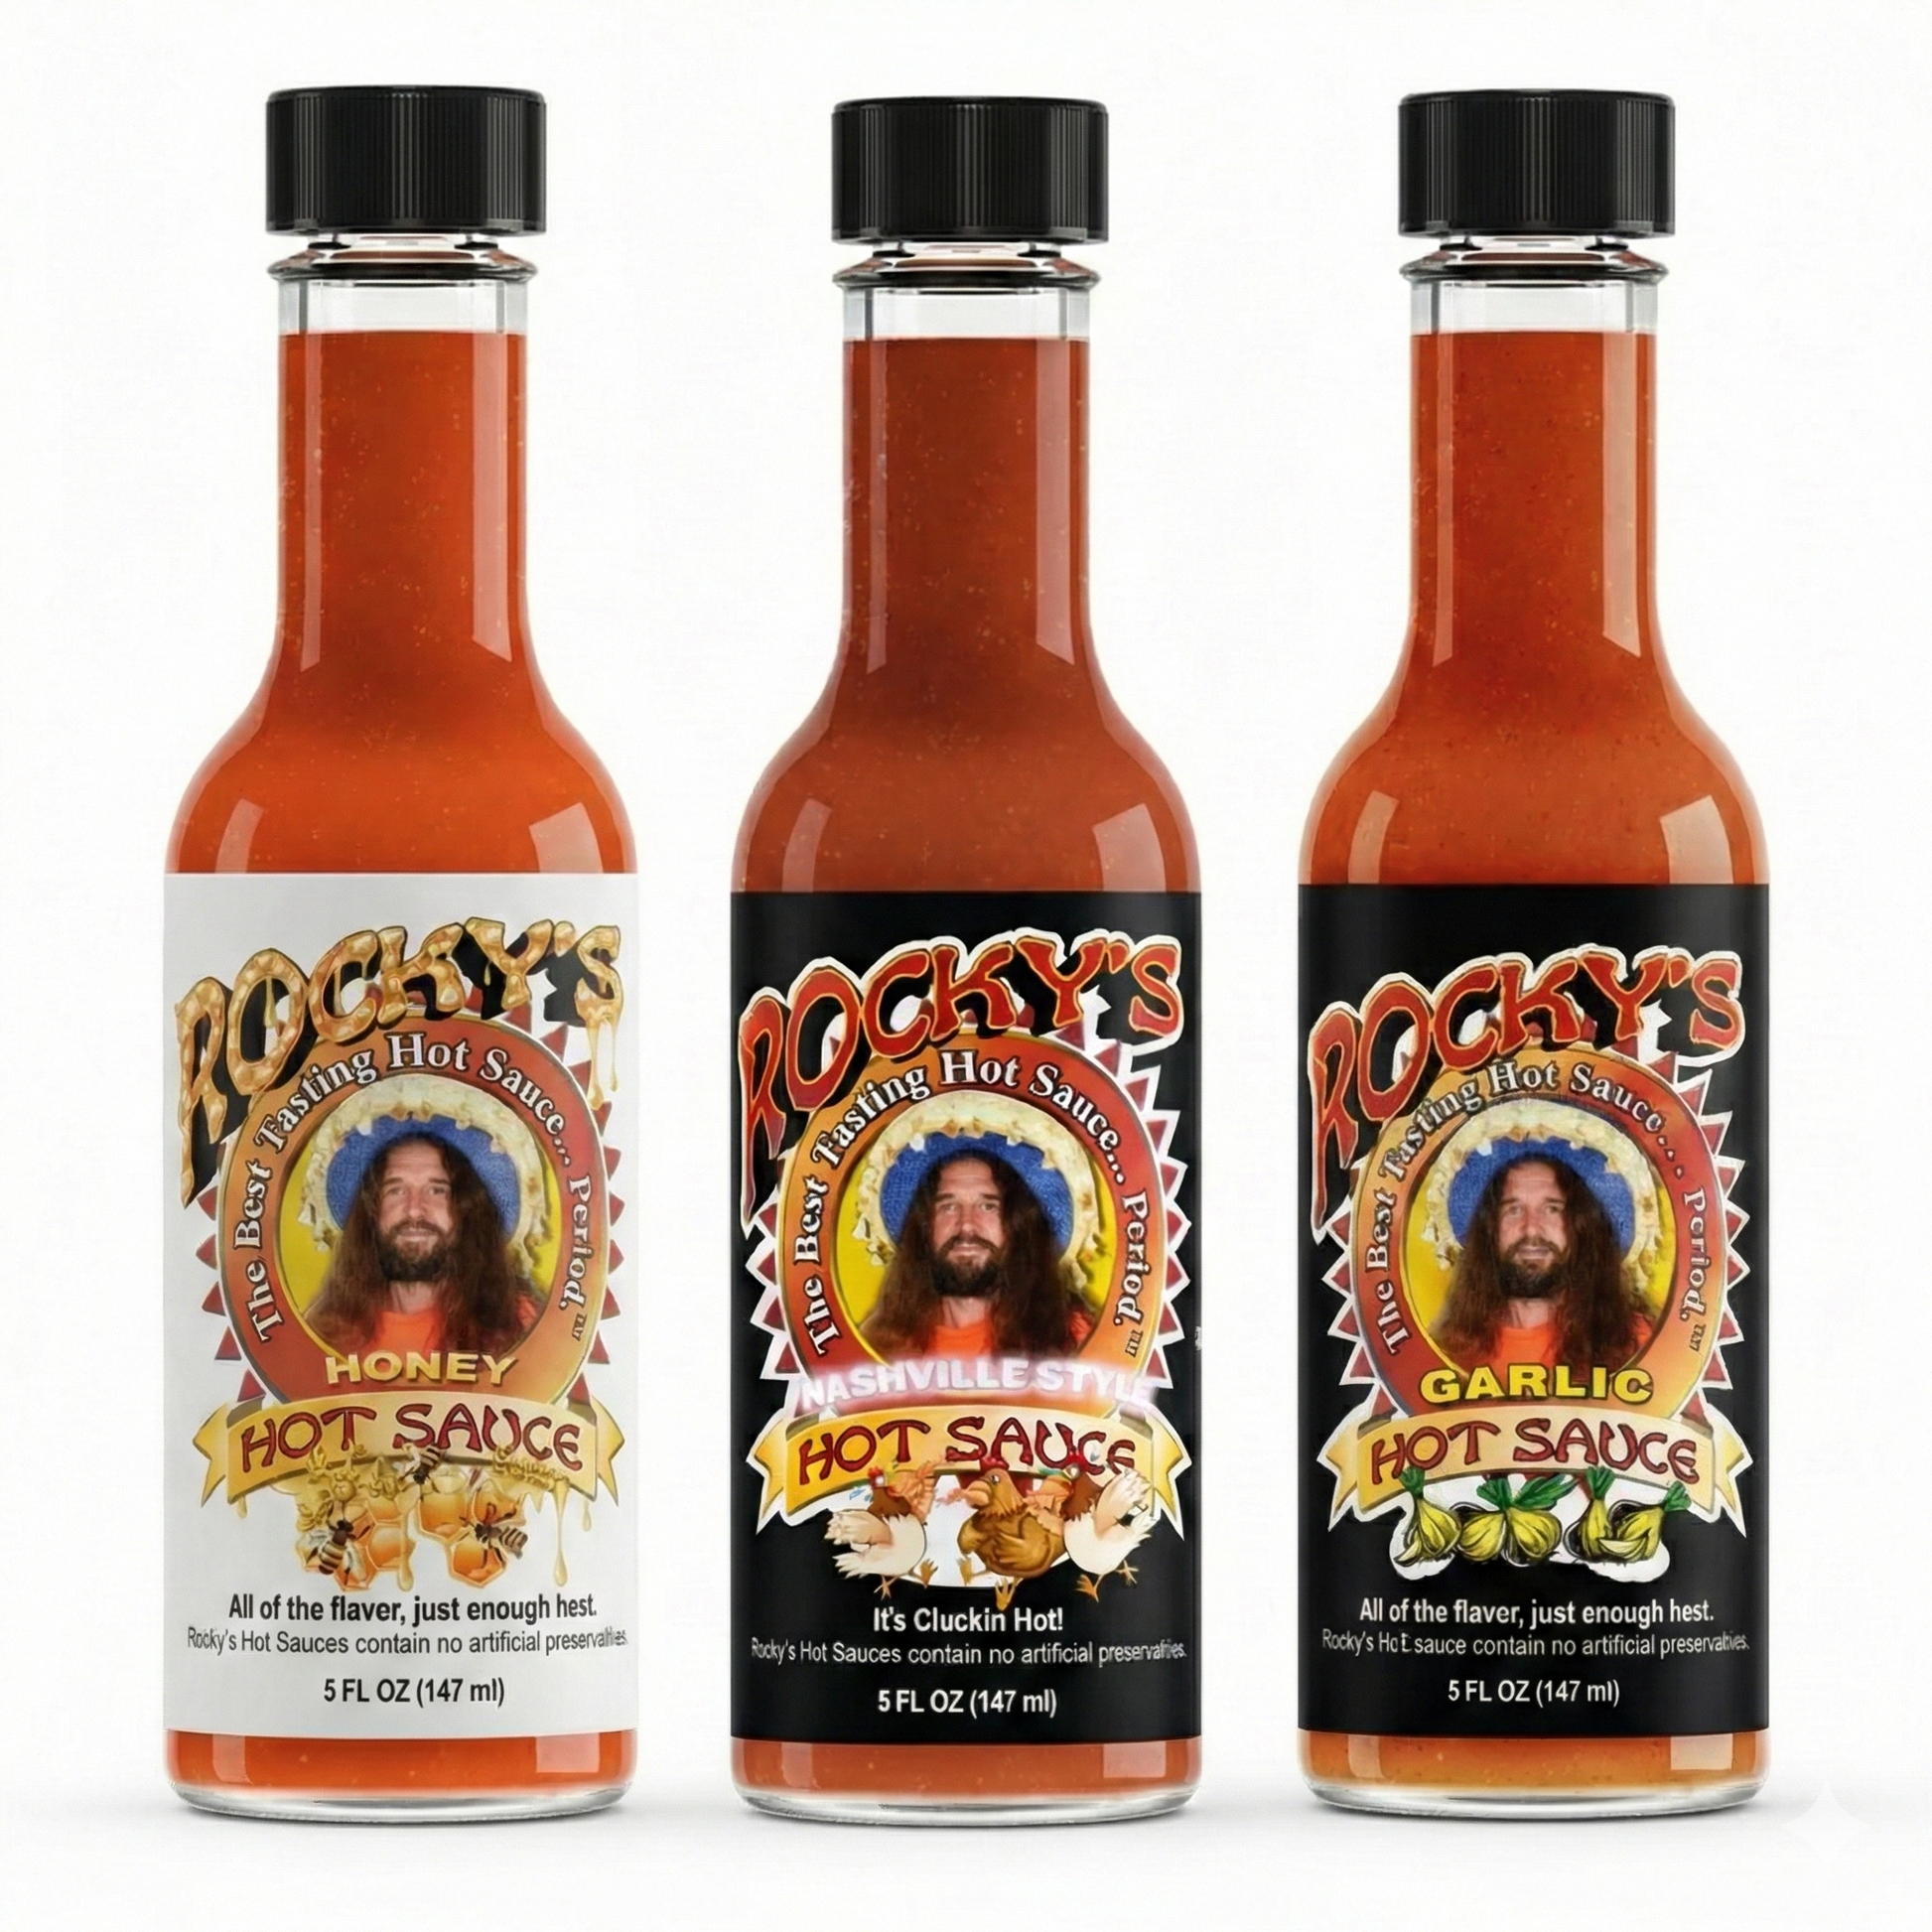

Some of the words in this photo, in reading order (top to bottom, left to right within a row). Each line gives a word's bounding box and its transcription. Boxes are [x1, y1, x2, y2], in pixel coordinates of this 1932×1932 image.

[175, 917, 623, 1208] ROCKY'S
[385, 1033, 471, 1071] Hot
[739, 929, 1183, 1233] ROCKY'S
[938, 1048, 1021, 1088] Hot
[1489, 1058, 1560, 1094] Hot
[254, 1048, 376, 1154] Tasting
[810, 1066, 928, 1170] Tasting
[1309, 945, 1744, 1239] ROCKY'S
[1379, 1080, 1484, 1182] Tasting
[232, 1159, 273, 1250] Best
[793, 1174, 830, 1266] Best
[1365, 1187, 1397, 1273] Best
[245, 1256, 285, 1343] The
[803, 1275, 842, 1356] The
[1375, 1280, 1413, 1355] The
[326, 1351, 519, 1386] HONEY
[800, 1358, 1030, 1408] NASHVILLE
[1035, 1361, 1152, 1407] STYLE
[1420, 1364, 1653, 1403] GARLIC
[240, 1406, 377, 1473] HOT
[392, 1403, 584, 1471] SAUCE
[798, 1419, 930, 1485] HOT
[945, 1417, 1136, 1475] SAUCE
[1371, 1421, 1500, 1484] HOT
[1512, 1418, 1700, 1484] SAUCE
[229, 1593, 254, 1619] All
[259, 1593, 281, 1620] of
[287, 1595, 324, 1620] the
[331, 1595, 406, 1626] flaver,
[412, 1595, 460, 1627] just
[467, 1593, 550, 1626] enough
[556, 1592, 598, 1618] hest.
[874, 1606, 905, 1631] It's
[913, 1606, 1006, 1631] Cluckin
[1014, 1607, 1063, 1631] Hot!
[1359, 1597, 1383, 1621] All
[1389, 1598, 1410, 1621] of
[1414, 1598, 1448, 1622] the
[1452, 1599, 1524, 1628] flaver,
[1530, 1599, 1576, 1629] just
[1583, 1599, 1663, 1629] enough
[1670, 1598, 1715, 1622] hest.
[188, 1626, 237, 1656] Rocky's
[241, 1630, 271, 1652] Hot
[276, 1630, 349, 1653] Sauces
[355, 1632, 430, 1654] contain
[438, 1637, 463, 1653] no
[469, 1630, 540, 1653] artificial
[800, 1641, 827, 1662] Hot
[832, 1642, 901, 1663] Sauces
[908, 1643, 982, 1664] contain
[990, 1649, 1015, 1664] no
[1021, 1641, 1092, 1664] artificial
[1322, 1628, 1374, 1657] Rocky's
[1414, 1638, 1466, 1654] sauce
[1473, 1634, 1545, 1655] contain
[1552, 1640, 1576, 1655] no
[1582, 1634, 1655, 1655] artificial
[324, 1678, 337, 1703] 5
[343, 1679, 370, 1703] FL
[376, 1678, 411, 1703] OZ
[416, 1678, 464, 1708] (147
[470, 1677, 505, 1708] ml)
[878, 1690, 891, 1713] 5
[897, 1690, 924, 1713] FL
[930, 1690, 964, 1713] OZ
[970, 1689, 1017, 1719] (147
[1023, 1689, 1057, 1719] ml)
[1448, 1680, 1459, 1701] 5
[1465, 1680, 1492, 1702] FL
[1498, 1680, 1530, 1702] OZ
[1536, 1680, 1581, 1708] (147
[1587, 1680, 1619, 1708] ml)
